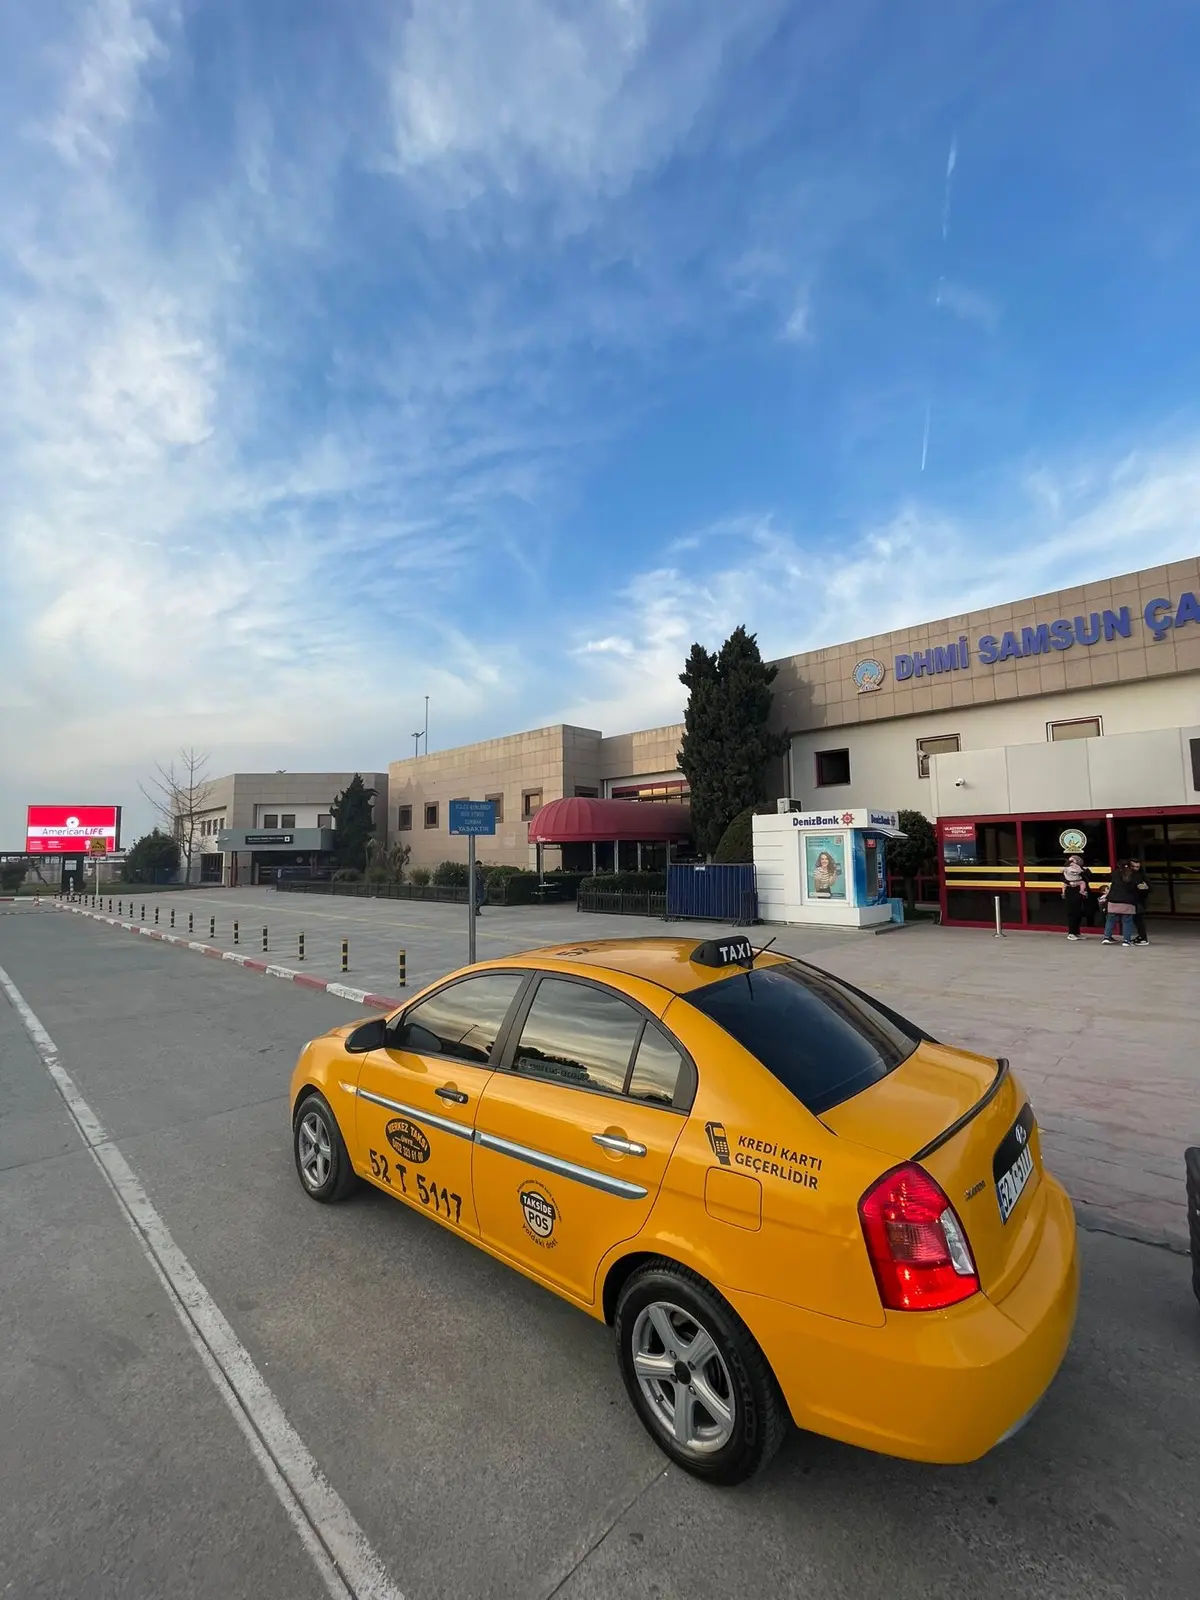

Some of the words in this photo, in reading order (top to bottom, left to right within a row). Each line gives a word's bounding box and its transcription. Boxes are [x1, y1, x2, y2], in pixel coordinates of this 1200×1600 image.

[895, 636, 969, 681] DHMİ
[978, 606, 1132, 664] SAMSUN
[1144, 592, 1200, 641] ÇA
[793, 816, 839, 826] DenizBank
[871, 814, 890, 826] DenizBank
[719, 942, 751, 962] TAXI
[387, 1121, 409, 1134] MERKEZ
[738, 1135, 778, 1157] KREDİ
[780, 1148, 822, 1171] KARTI
[735, 1152, 818, 1190] GEÇERLİDİR
[369, 1148, 391, 1184] 52
[396, 1163, 407, 1193] T
[417, 1173, 462, 1224] 5117
[999, 1178, 1013, 1213] 52
[522, 1195, 553, 1217] TAKSİDE
[528, 1211, 549, 1231] POS
